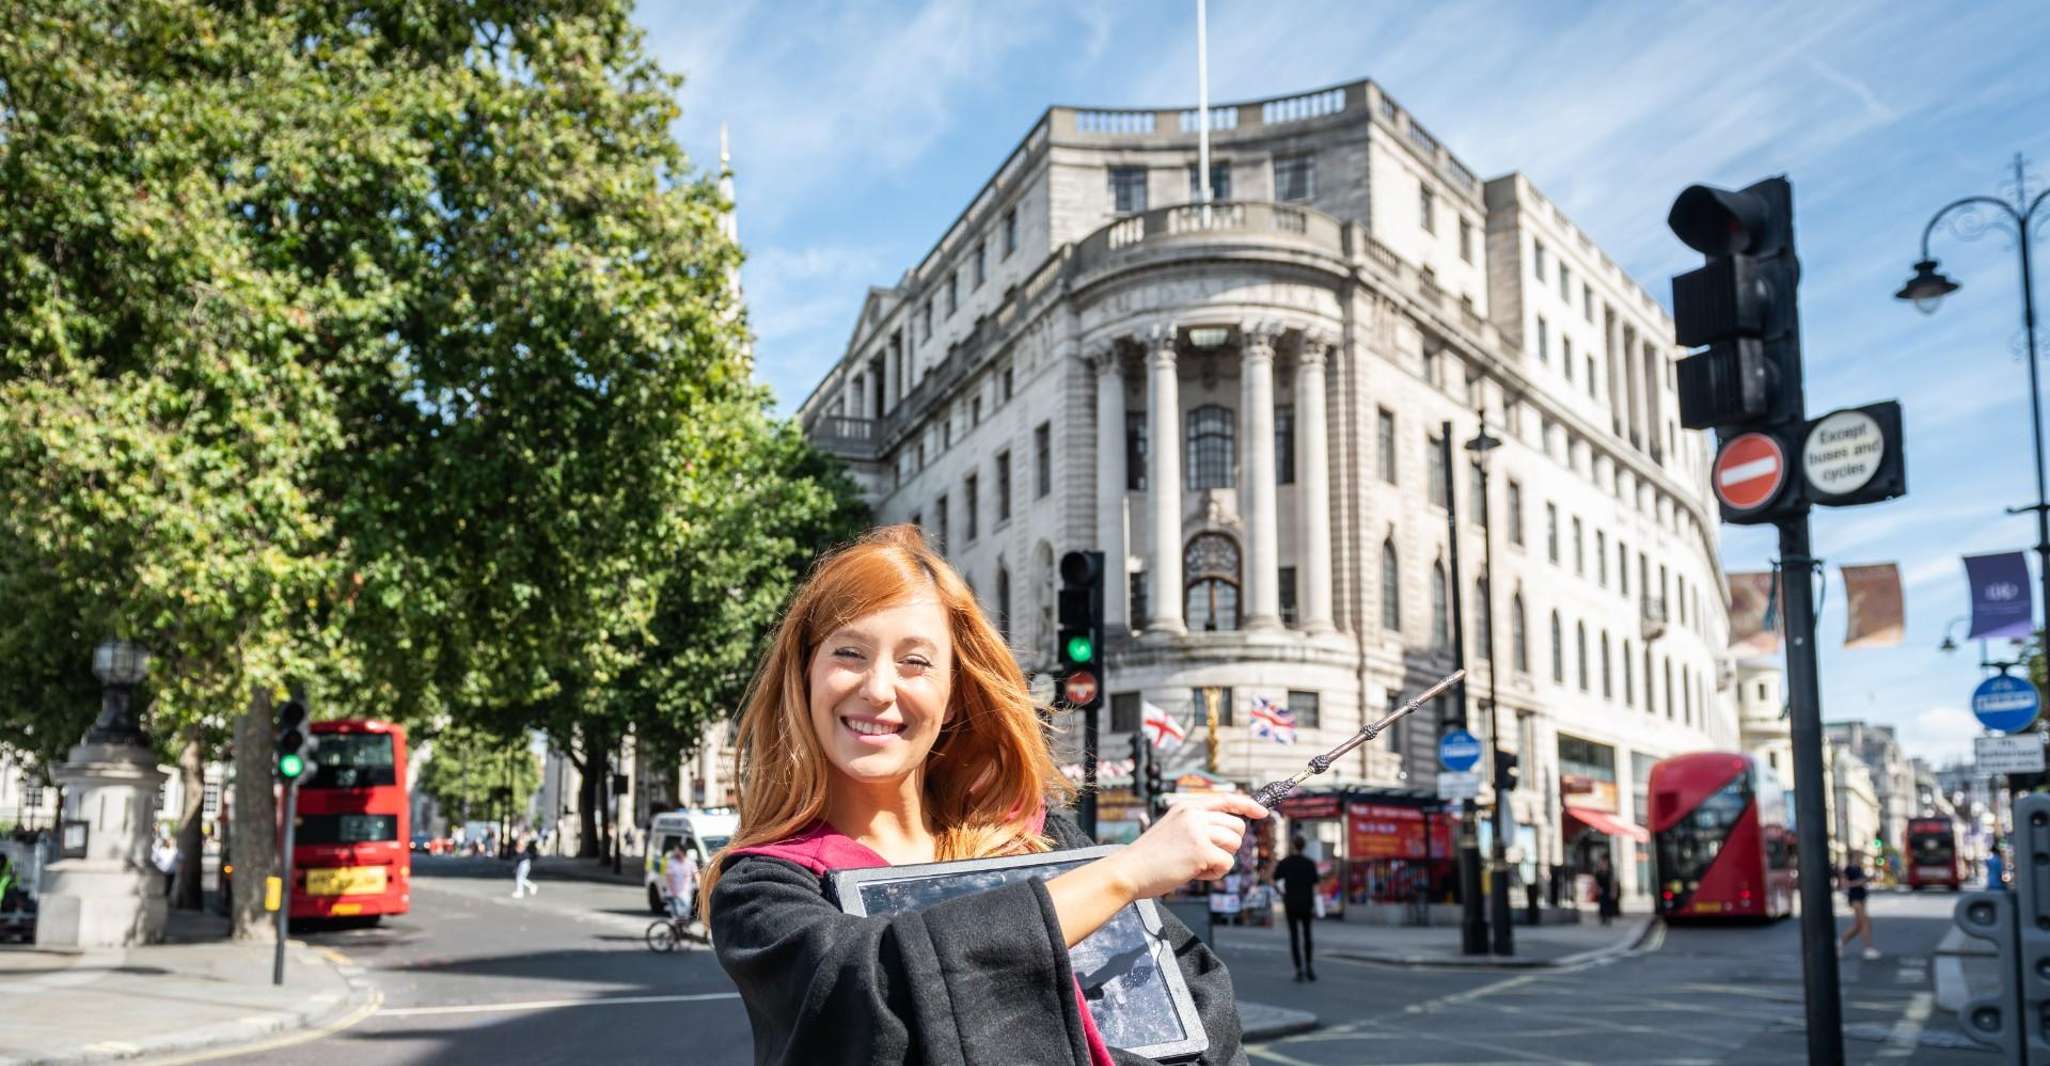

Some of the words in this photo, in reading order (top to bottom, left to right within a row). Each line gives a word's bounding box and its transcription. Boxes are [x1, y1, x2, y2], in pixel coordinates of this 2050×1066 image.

[1819, 423, 1866, 444] Except
[1809, 447, 1848, 465] buses
[1854, 440, 1881, 456] and
[1822, 464, 1866, 483] cycles
